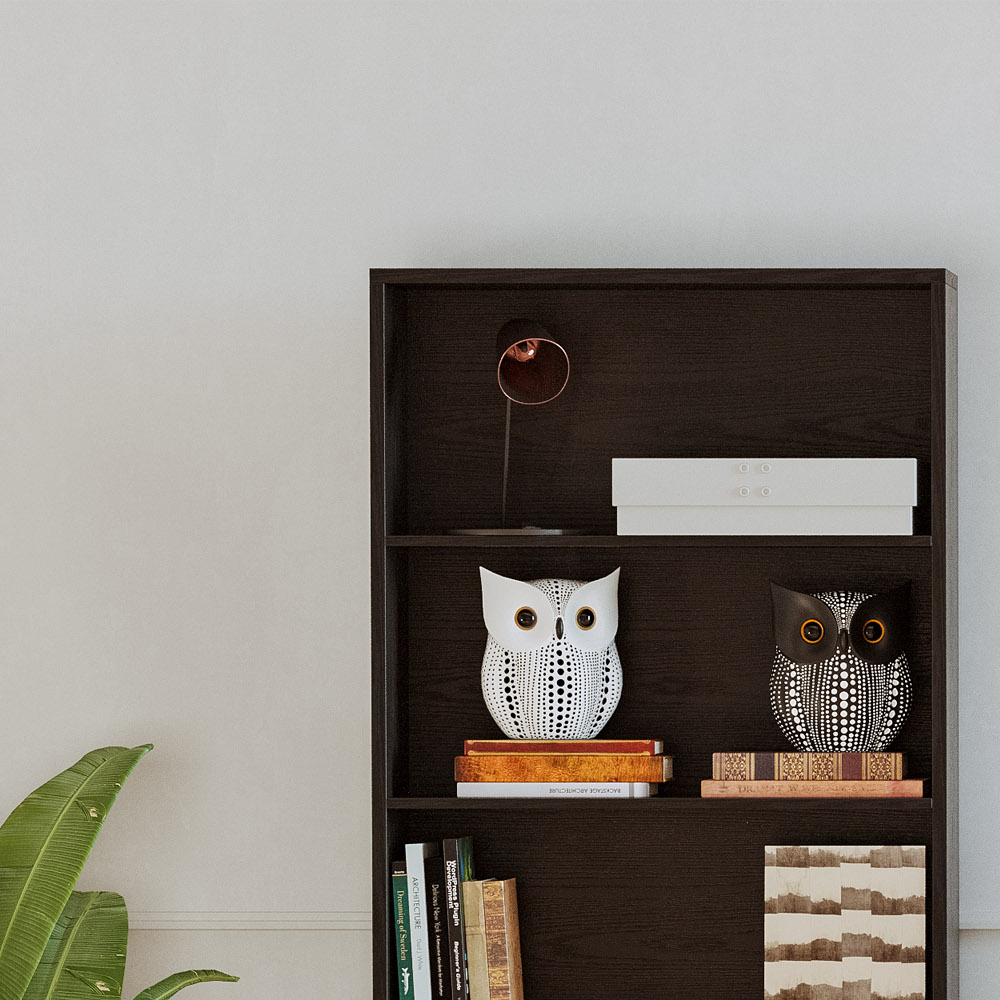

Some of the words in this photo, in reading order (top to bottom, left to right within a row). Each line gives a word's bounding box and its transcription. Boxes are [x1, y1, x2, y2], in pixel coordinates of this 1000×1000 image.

[446, 860, 454, 909] Development
[396, 890, 406, 924] Dreaming
[412, 877, 422, 930] ARCHITECTURE
[433, 907, 441, 921] New
[452, 902, 460, 926] Plugin
[399, 925, 407, 933] of
[434, 921, 442, 933] York
[400, 934, 408, 961] Sweden
[453, 941, 461, 973] Beginner's
